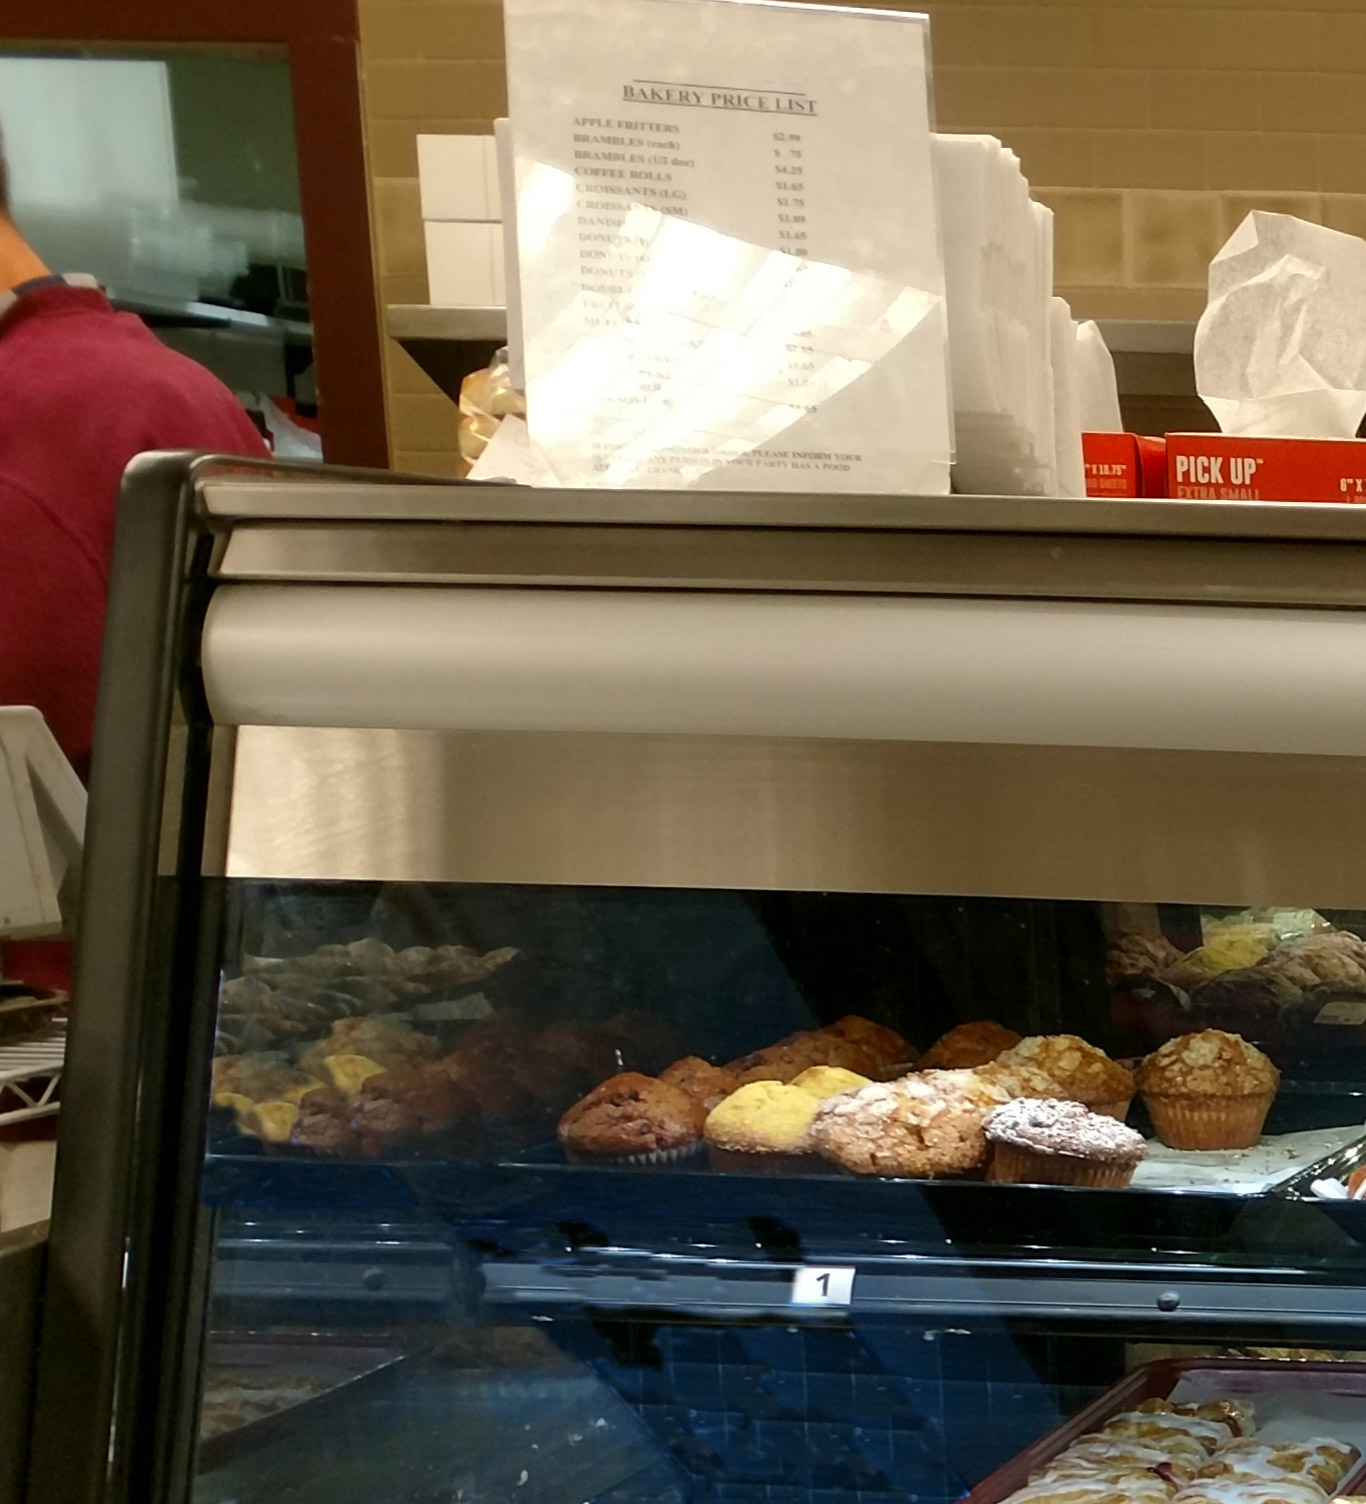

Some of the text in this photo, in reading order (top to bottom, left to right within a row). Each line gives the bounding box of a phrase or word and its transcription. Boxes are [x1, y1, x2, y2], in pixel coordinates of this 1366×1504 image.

[623, 85, 817, 113] BAKERY PRICE LIST
[573, 117, 613, 129] APPLE
[573, 133, 644, 147] BRAMBLES
[574, 150, 645, 164] BRAMBLES
[575, 166, 672, 182] COFFEE ROLLS
[1176, 455, 1224, 484] PICK
[816, 1272, 831, 1297] 1
